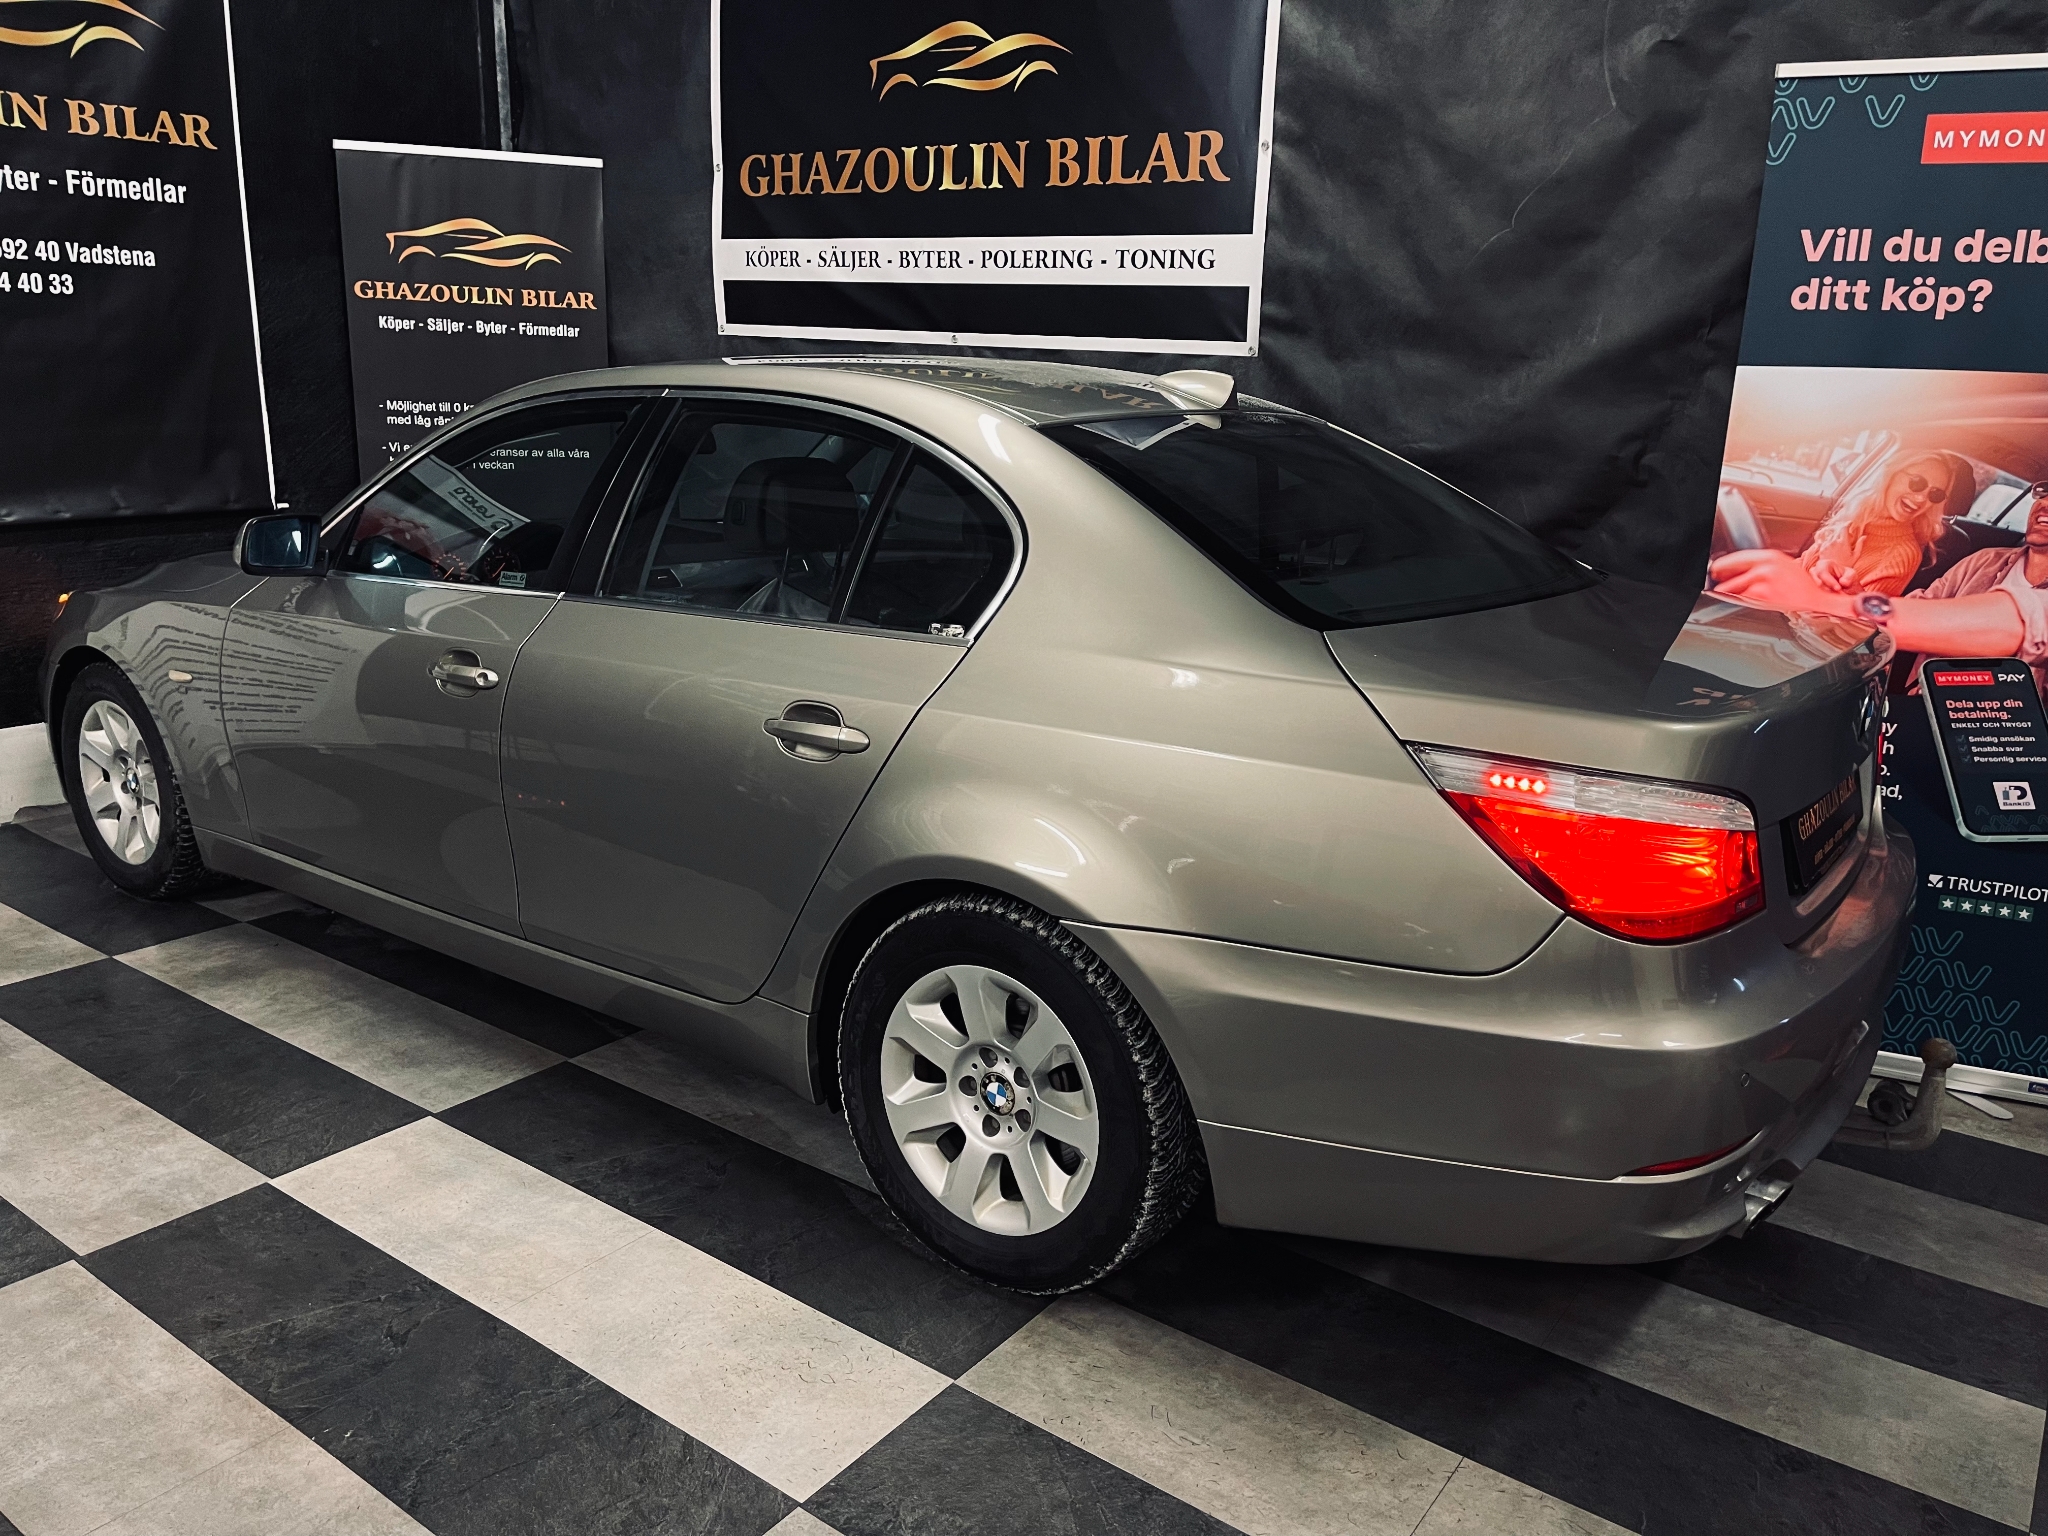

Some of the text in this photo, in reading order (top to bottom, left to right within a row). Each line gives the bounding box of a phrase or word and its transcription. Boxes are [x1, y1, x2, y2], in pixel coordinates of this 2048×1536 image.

[64, 98, 218, 150] BILAR
[1933, 129, 2046, 149] MYMON
[739, 129, 1231, 197] GHAZOULIN BILAR
[0, 164, 40, 193] ter
[65, 169, 187, 204] Förmedlar
[0, 237, 156, 267] 92 40 Vadstena
[1800, 227, 2048, 264] Vill du delb
[745, 246, 801, 268] KÖPER
[817, 246, 882, 273] SÄLJER
[899, 250, 963, 269] BYTER
[980, 249, 1093, 270] POLERING
[1115, 248, 1216, 270] TONING
[17, 272, 43, 294] 40
[48, 273, 74, 295] 33
[353, 280, 598, 310] GHAZOULIN BILAR
[1790, 275, 1993, 320] ditt köp?
[378, 315, 416, 331] Köper
[427, 317, 464, 335] Säljer
[476, 320, 507, 336] Byter
[519, 322, 580, 338] Förmedlar
[386, 399, 437, 413] Möjlighet
[439, 402, 451, 412] till
[453, 402, 461, 412] 0
[386, 415, 412, 425] med
[414, 414, 432, 428] låg
[388, 442, 401, 453] Vi
[531, 449, 544, 457] av
[546, 448, 566, 458] alla
[567, 448, 590, 459] våra
[478, 460, 515, 470] veckan
[1997, 673, 2026, 682] PAY
[1945, 699, 2024, 710] Dela upp din
[1948, 710, 2012, 720] betalning.
[1947, 876, 2048, 903] TRUSTPILOT
